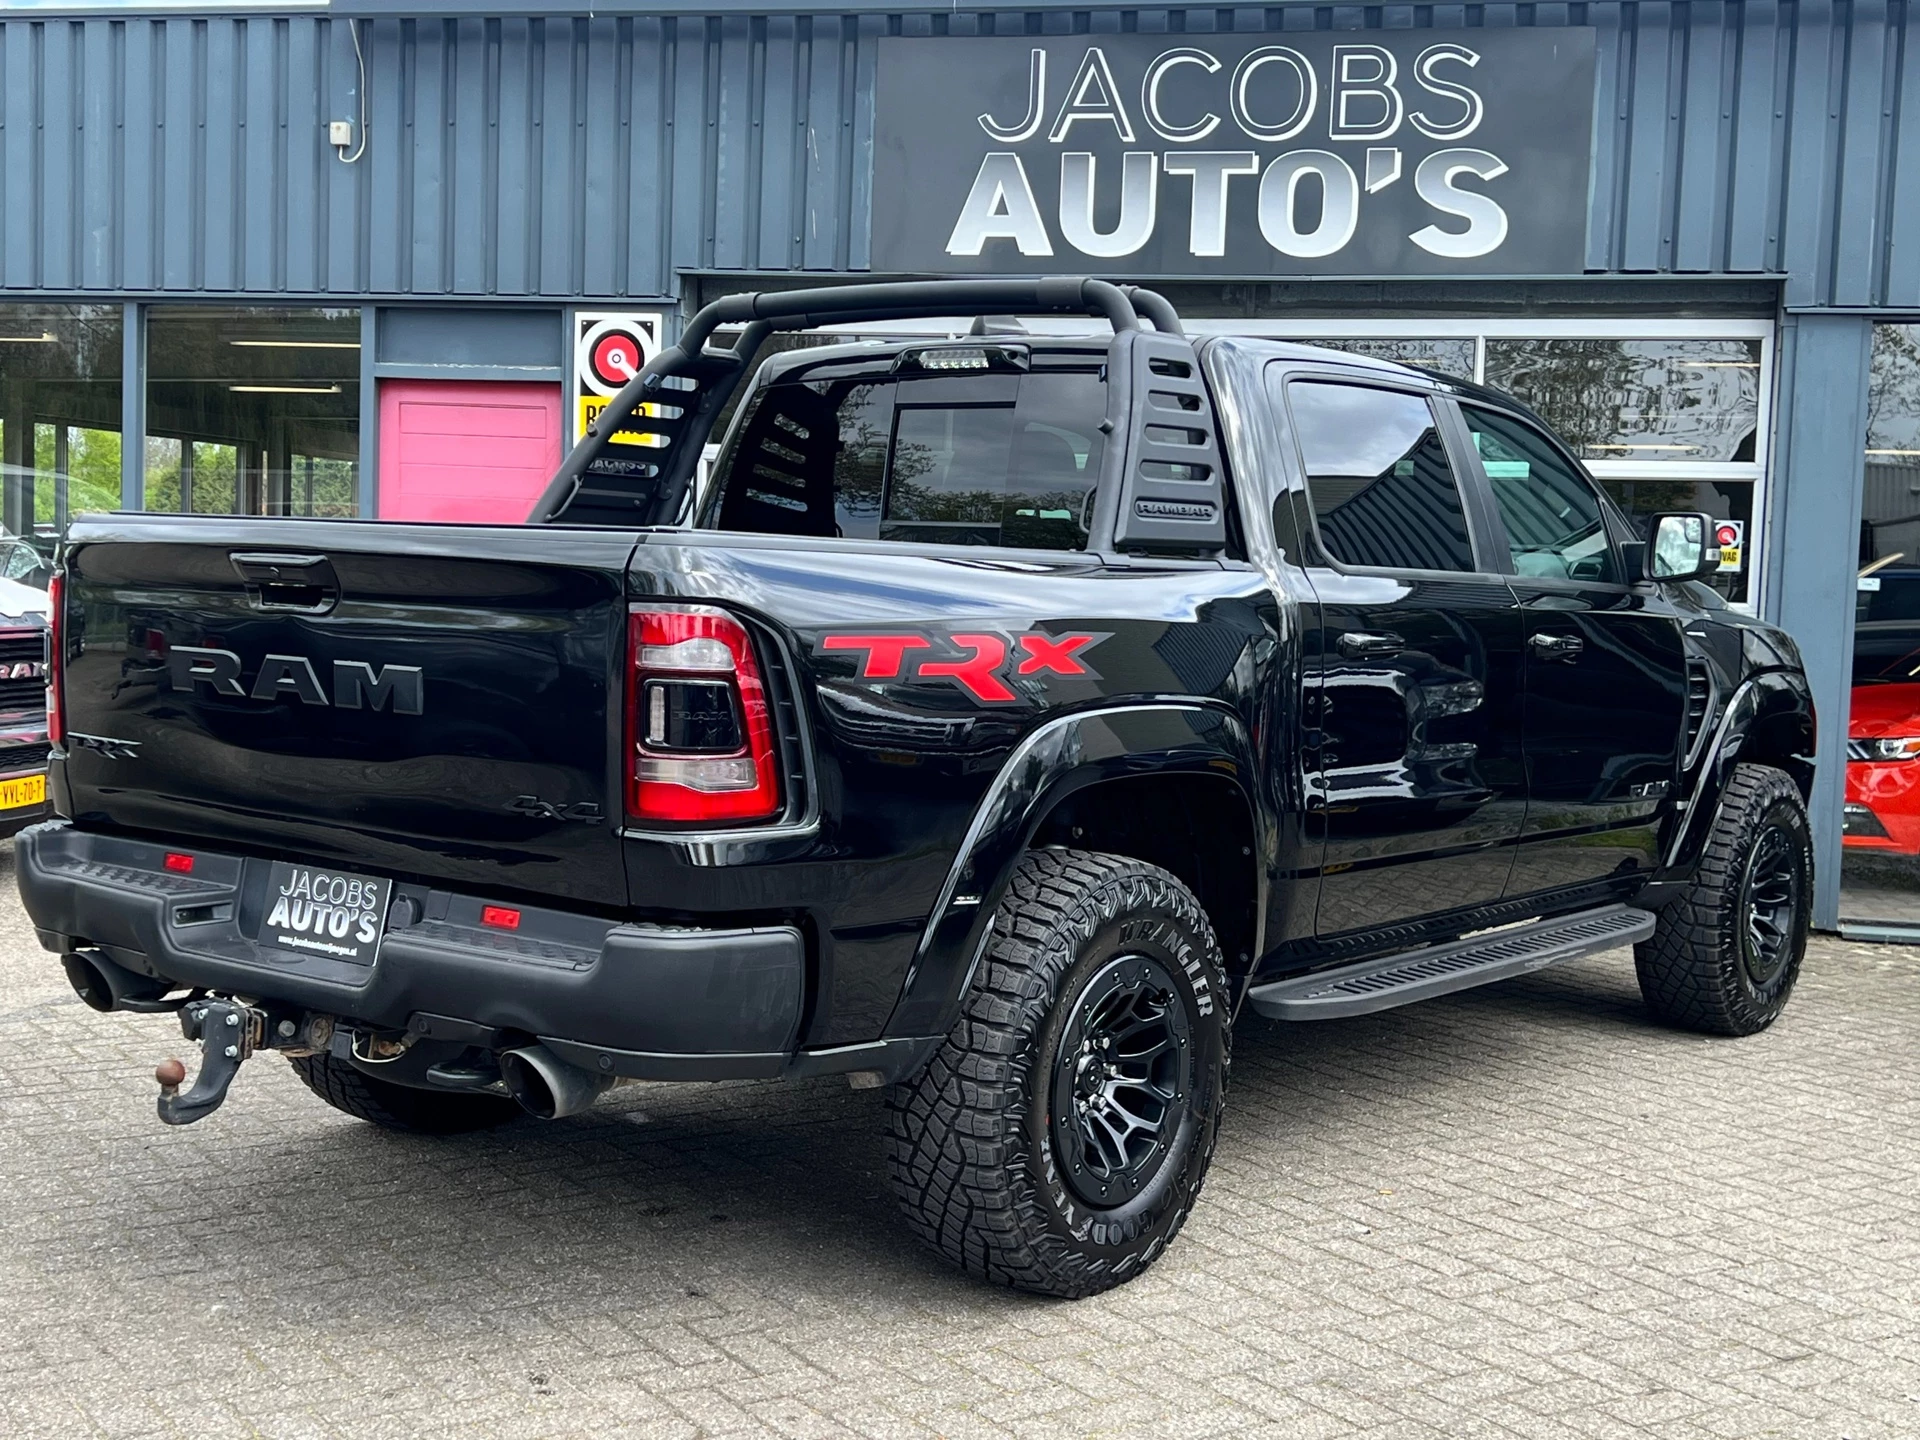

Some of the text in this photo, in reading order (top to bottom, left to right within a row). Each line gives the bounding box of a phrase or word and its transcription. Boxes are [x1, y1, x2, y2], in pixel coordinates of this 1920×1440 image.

[977, 44, 1484, 144] JACOBS
[945, 148, 1509, 258] AUTO'S
[1136, 503, 1213, 517] RAMBAR
[1719, 551, 1737, 562] VAG
[170, 645, 424, 716] RAM
[821, 633, 1097, 702] TRX
[67, 731, 143, 760] TRX
[280, 869, 377, 910] JACOBS
[267, 896, 378, 944] AUTO'S
[1118, 918, 1216, 1019] WRANGLER
